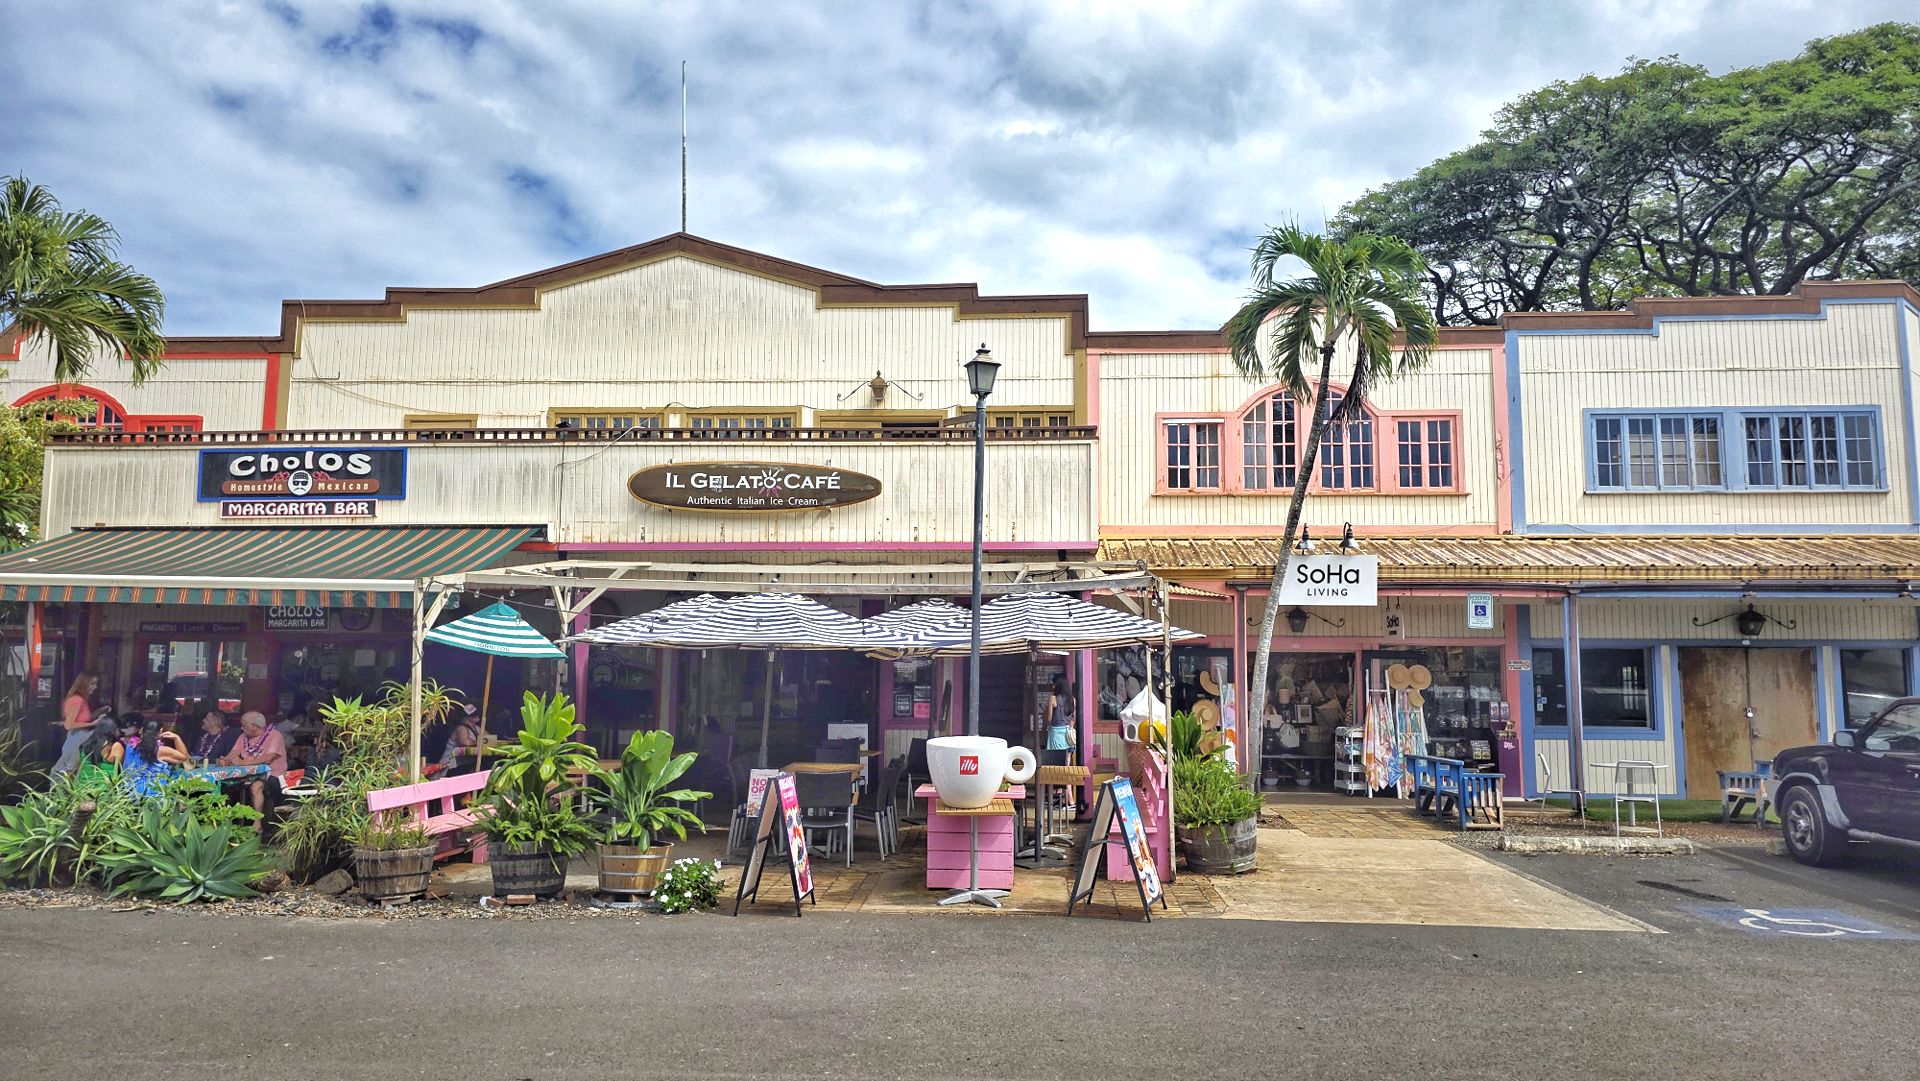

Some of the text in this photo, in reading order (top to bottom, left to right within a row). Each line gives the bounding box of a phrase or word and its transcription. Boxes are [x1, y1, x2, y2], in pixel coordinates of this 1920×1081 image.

[229, 451, 372, 477] Cholos
[230, 482, 369, 492] Homestyle Mexican
[665, 472, 685, 489] IL
[783, 472, 840, 490] CAFÉ
[686, 496, 818, 506] Authentic Italian Ice Cream
[228, 502, 369, 515] MARGARITA BAR
[1297, 564, 1360, 584] SoHa
[1307, 588, 1348, 597] LIVING
[269, 606, 324, 618] CHOLO'S
[268, 619, 325, 628] MARGARITA BAR
[960, 758, 978, 774] illy
[752, 778, 767, 787] NO
